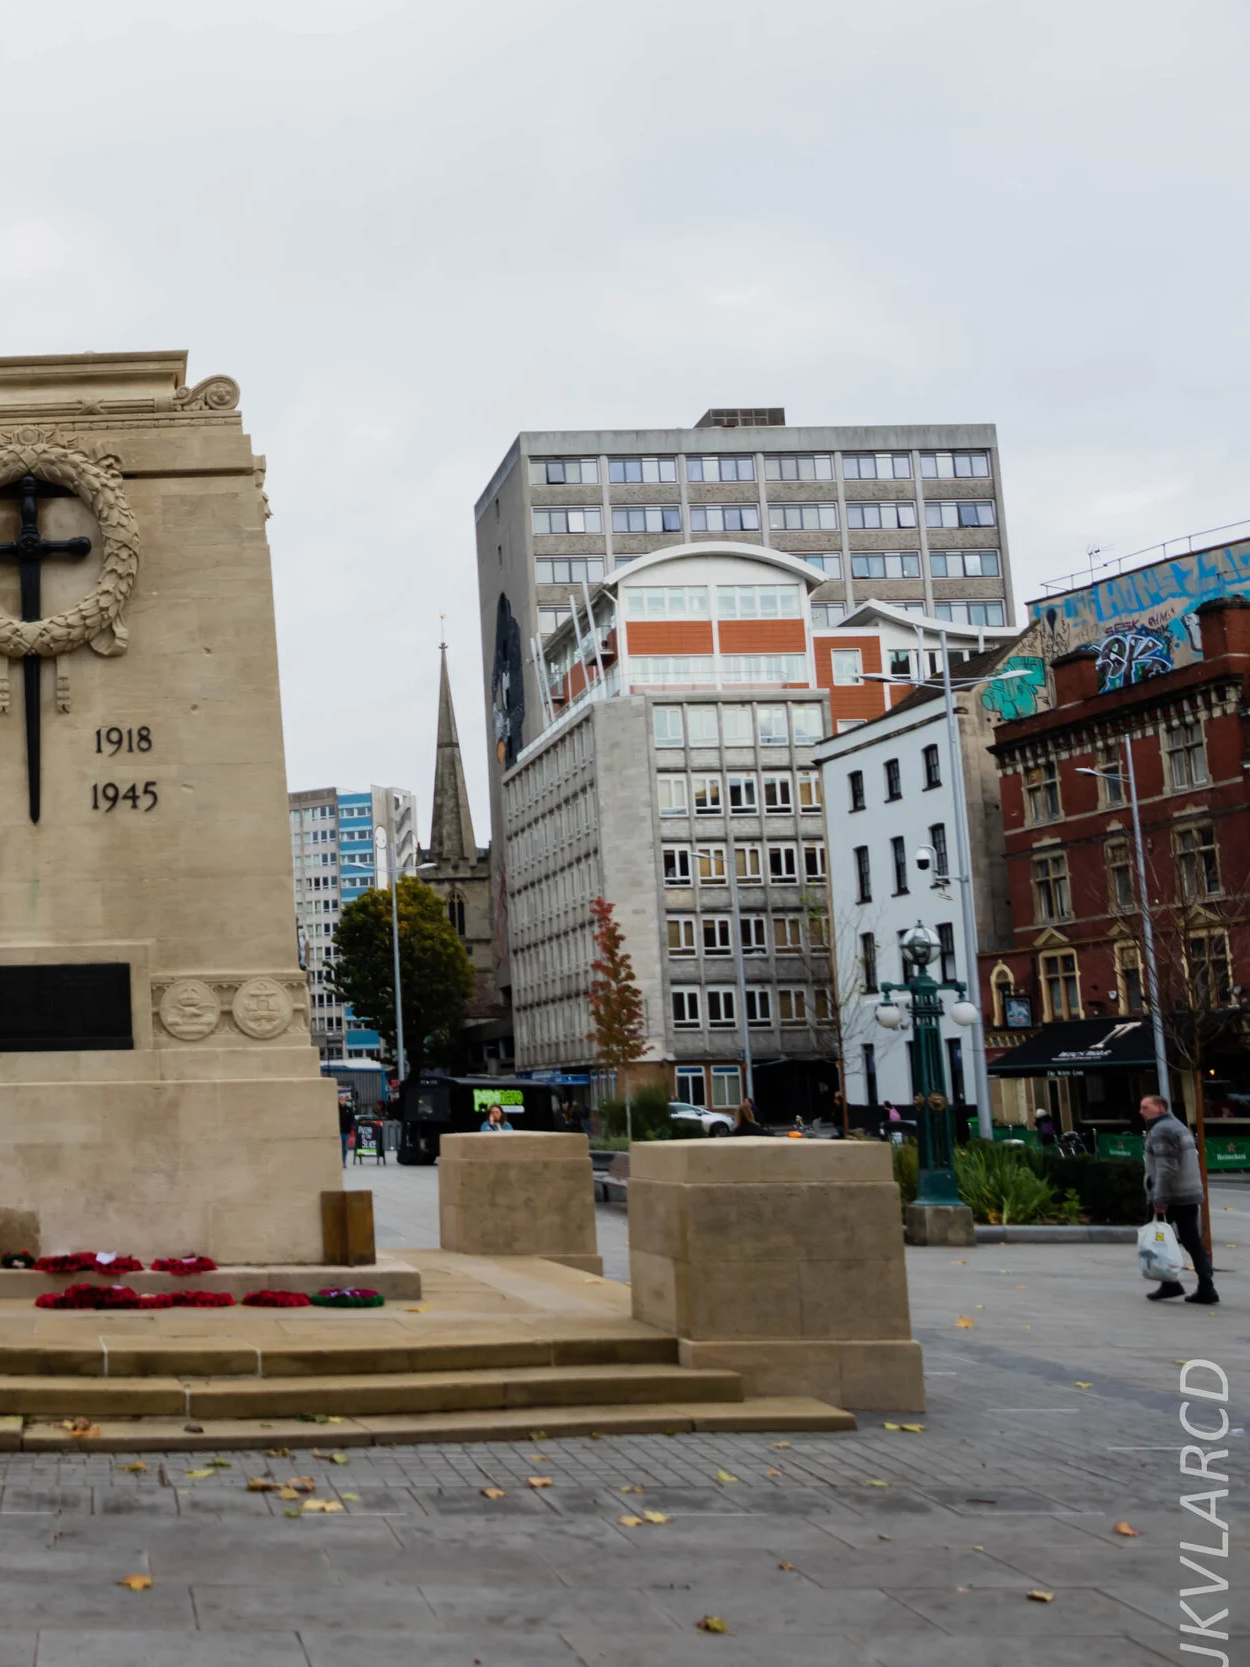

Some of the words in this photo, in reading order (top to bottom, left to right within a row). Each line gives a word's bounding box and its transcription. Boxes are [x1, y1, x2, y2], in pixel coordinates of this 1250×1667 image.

[95, 726, 153, 757] 1918
[91, 781, 159, 813] 1945
[1216, 1153, 1247, 1161] Heineken
